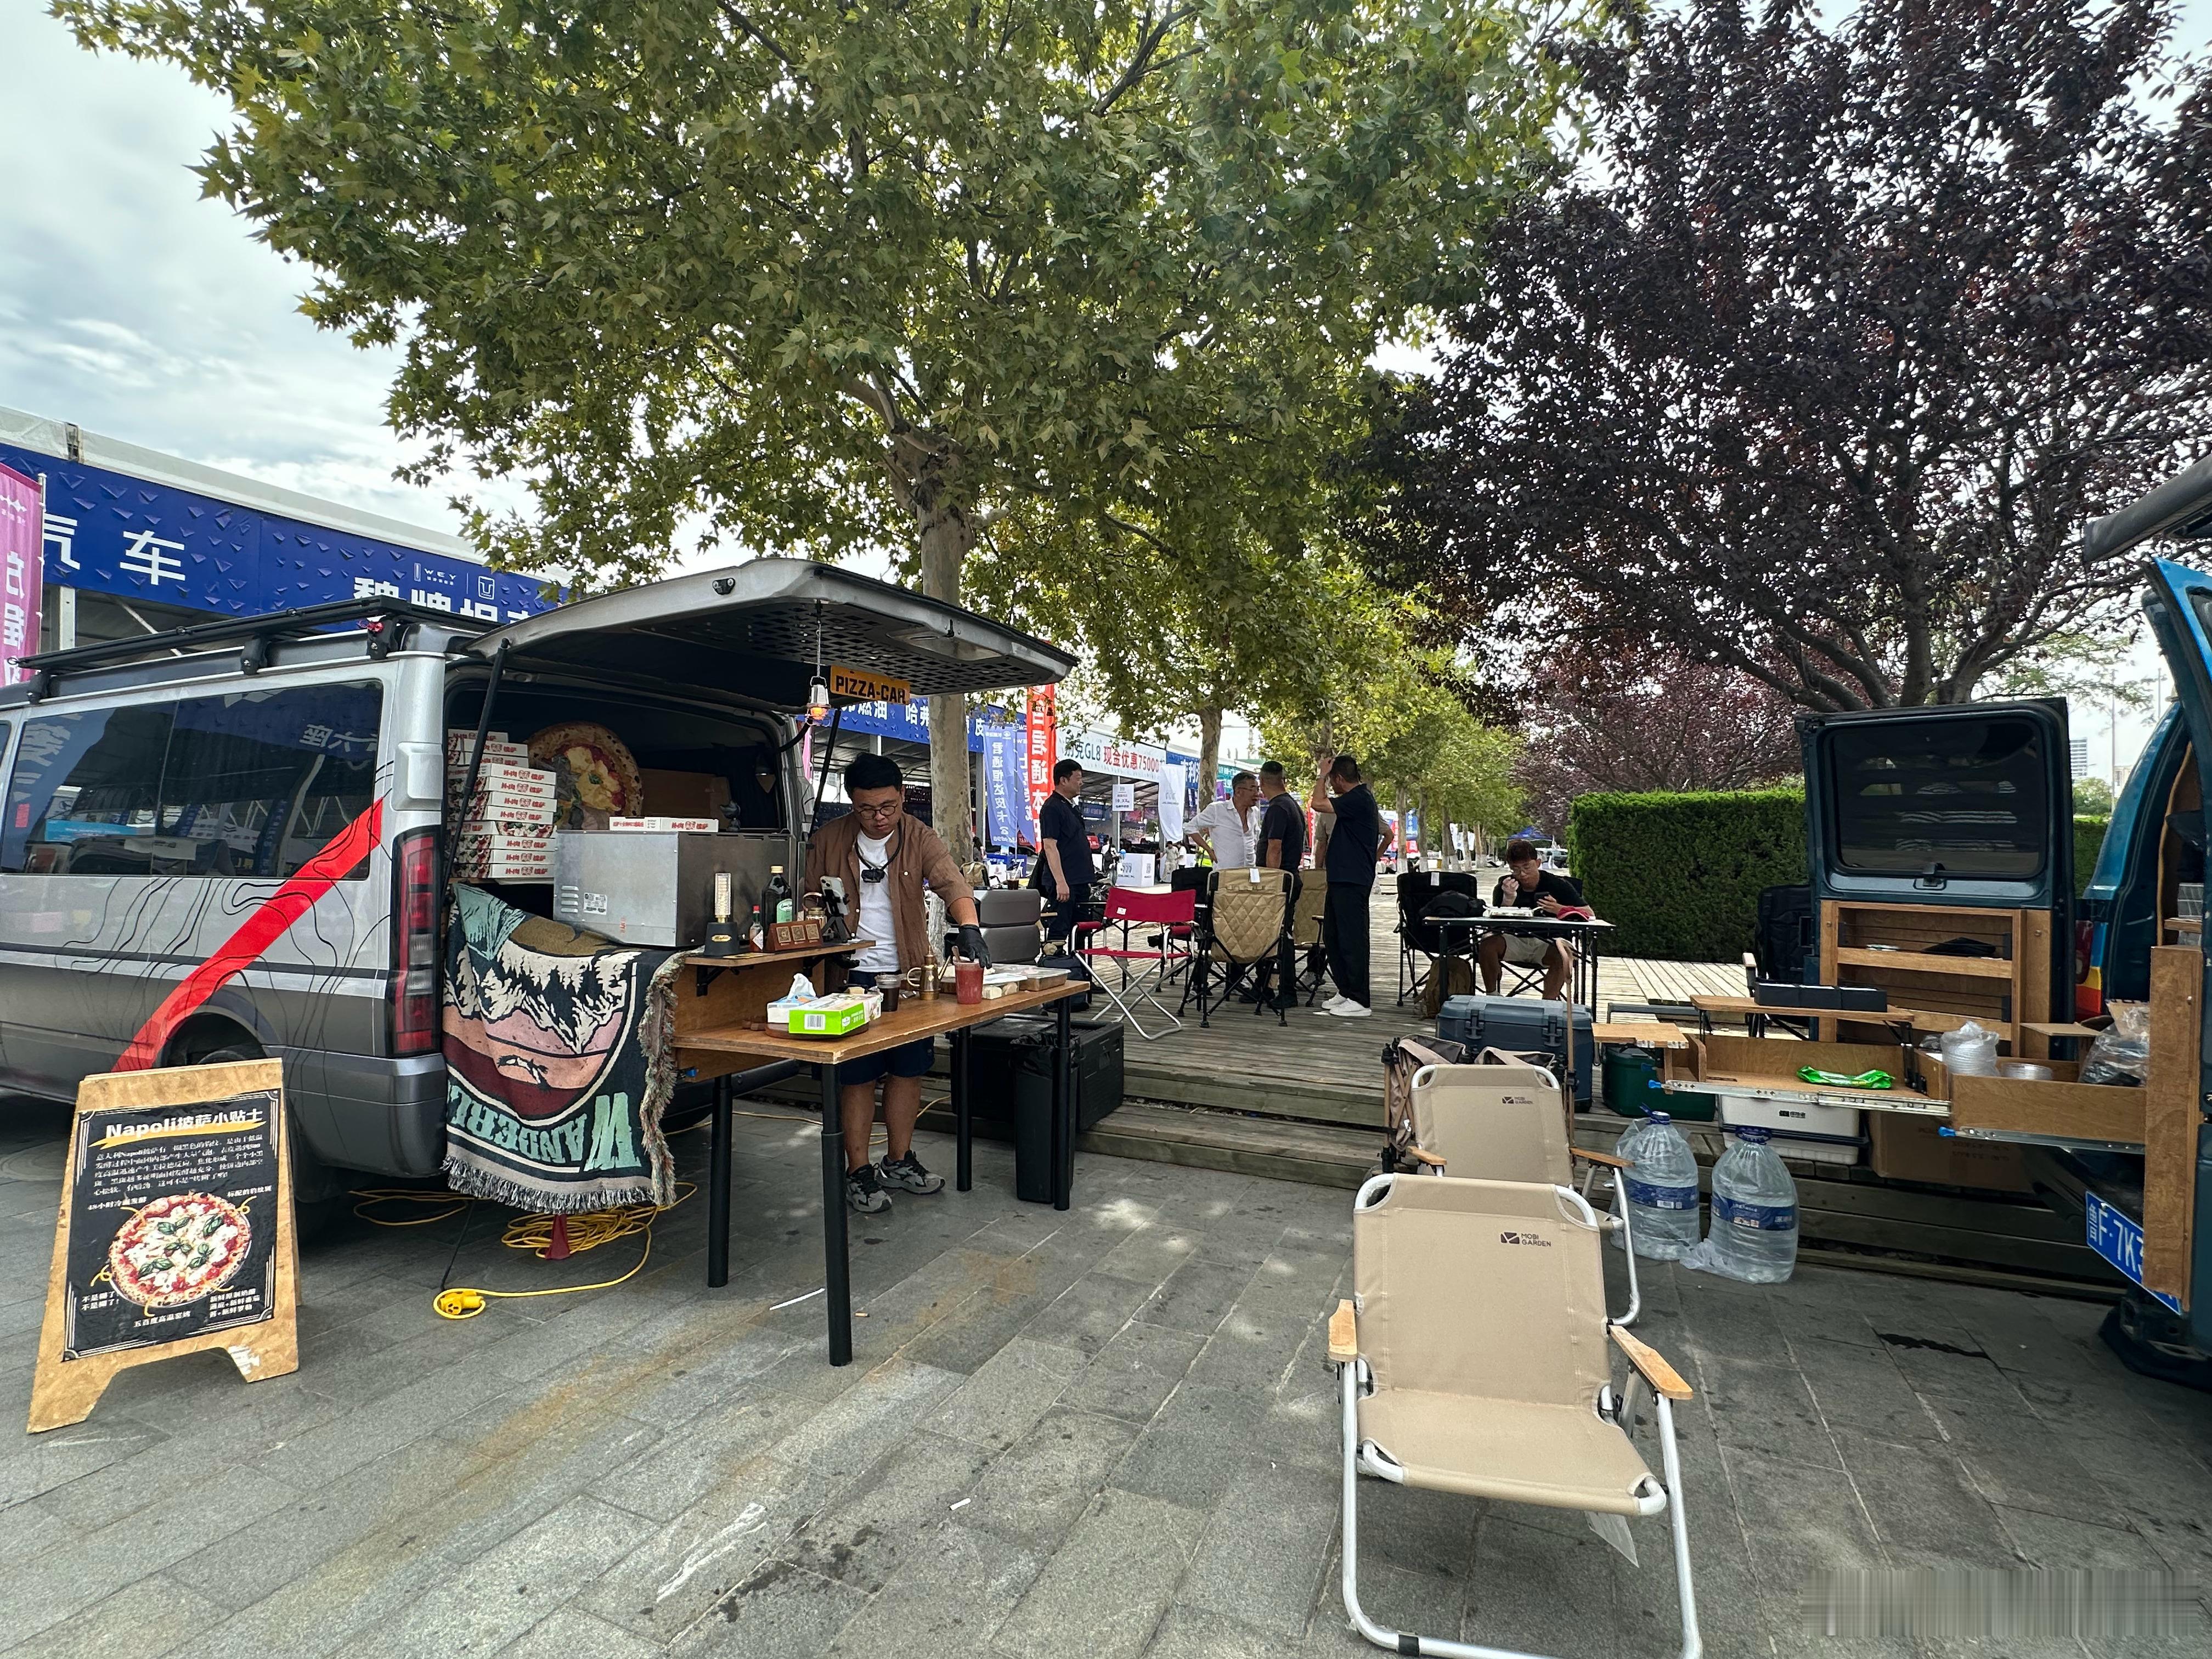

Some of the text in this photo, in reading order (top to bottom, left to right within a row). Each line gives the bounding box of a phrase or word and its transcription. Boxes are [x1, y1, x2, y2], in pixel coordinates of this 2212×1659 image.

[424, 568, 457, 580] WEY
[836, 675, 907, 704] PIZZA-CAR
[106, 1108, 263, 1138] Napoli披萨小贴士
[1521, 1239, 1551, 1247] GARDEN
[2089, 1202, 2145, 1277] 鲁F·7K
